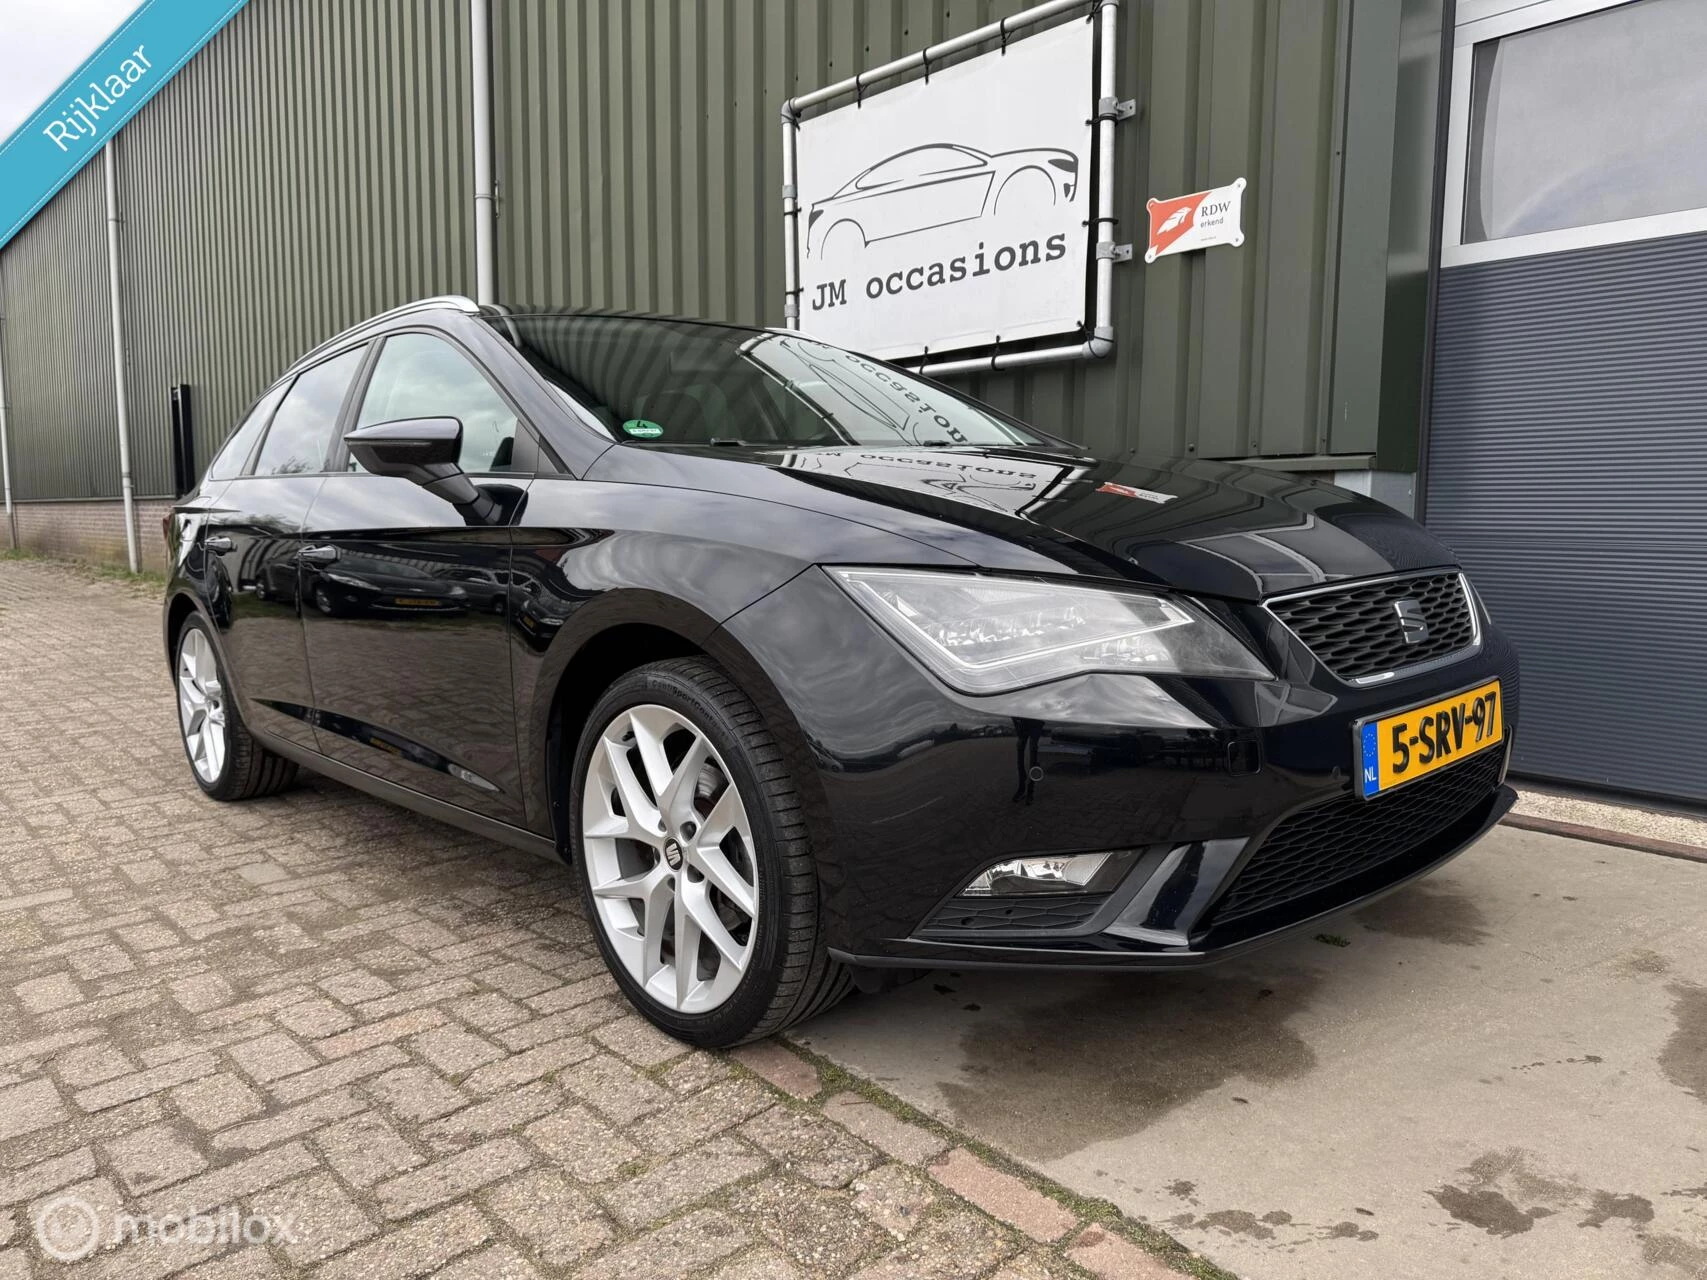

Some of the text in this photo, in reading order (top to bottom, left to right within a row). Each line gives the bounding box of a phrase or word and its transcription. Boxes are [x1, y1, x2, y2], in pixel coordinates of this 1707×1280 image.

[1201, 200, 1231, 217] RDW
[1200, 217, 1224, 228] erkend
[812, 233, 1067, 311] JM occasions
[636, 420, 648, 429] 4
[1391, 690, 1497, 775] 5-SRV-97
[1364, 766, 1377, 784] NL
